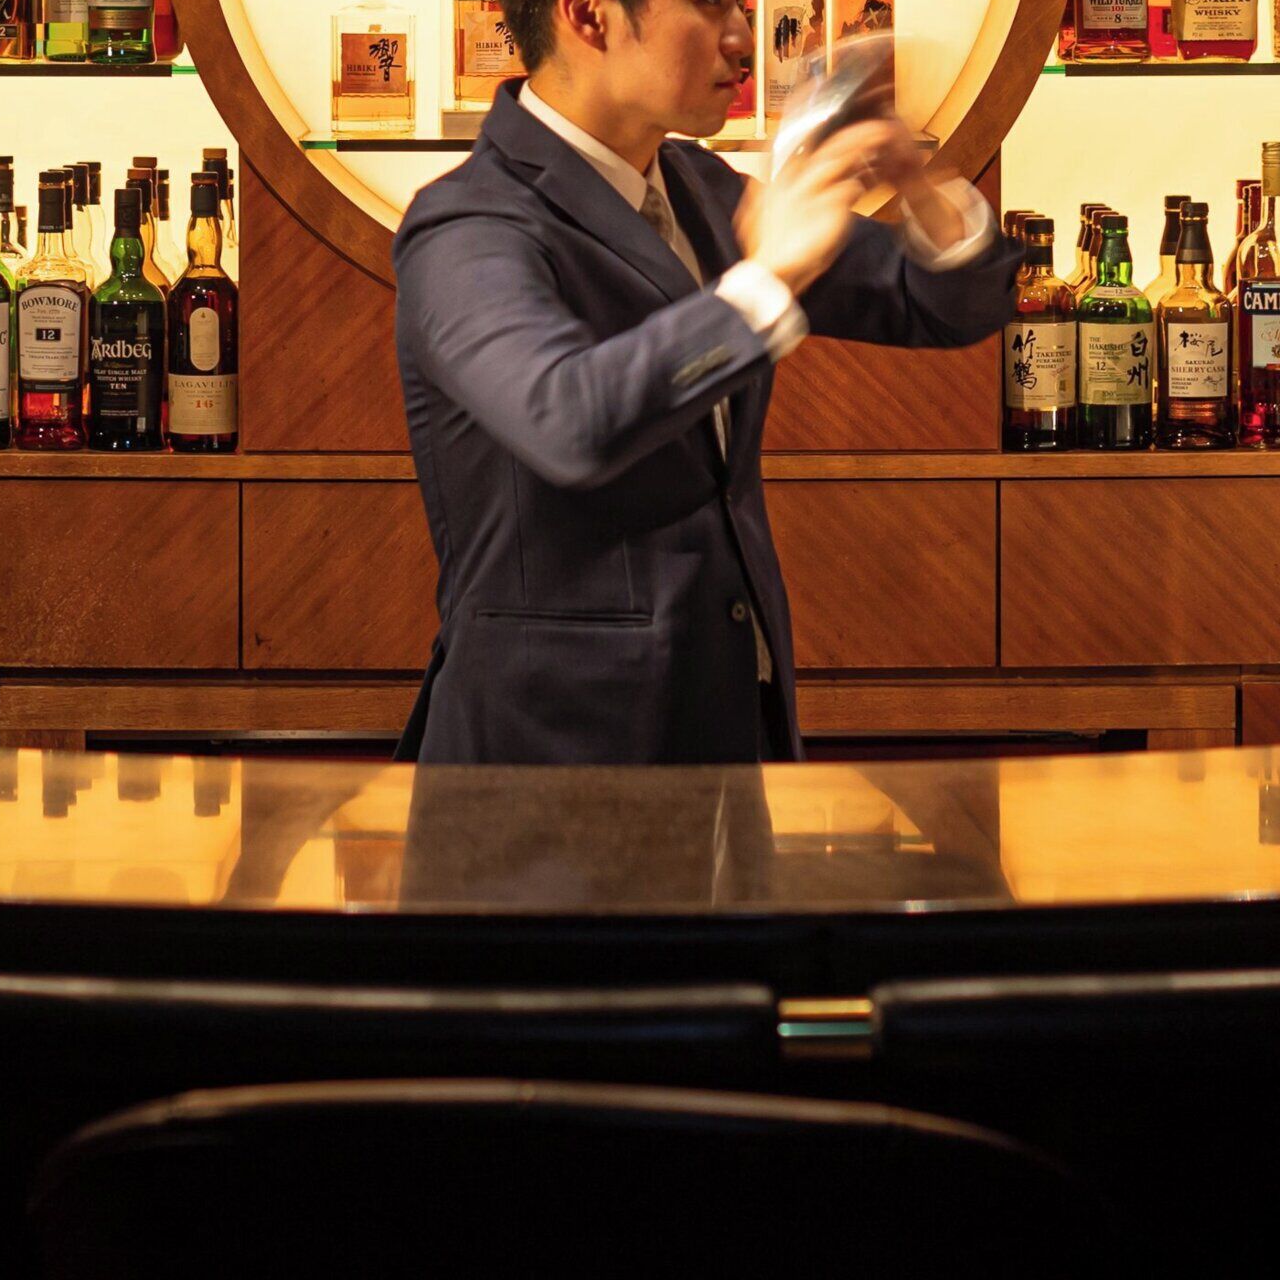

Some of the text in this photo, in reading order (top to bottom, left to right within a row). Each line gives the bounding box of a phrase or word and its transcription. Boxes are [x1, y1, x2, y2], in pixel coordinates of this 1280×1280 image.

[1114, 13, 1121, 23] 8
[370, 38, 403, 82] 響
[21, 296, 79, 313] BOWMORE
[40, 329, 55, 340] 12
[1089, 343, 1128, 351] HAKUSHU
[1011, 329, 1038, 390] 竹鶴
[1127, 331, 1149, 390] 白州
[1096, 361, 1106, 371] 12
[194, 400, 214, 409] 16
